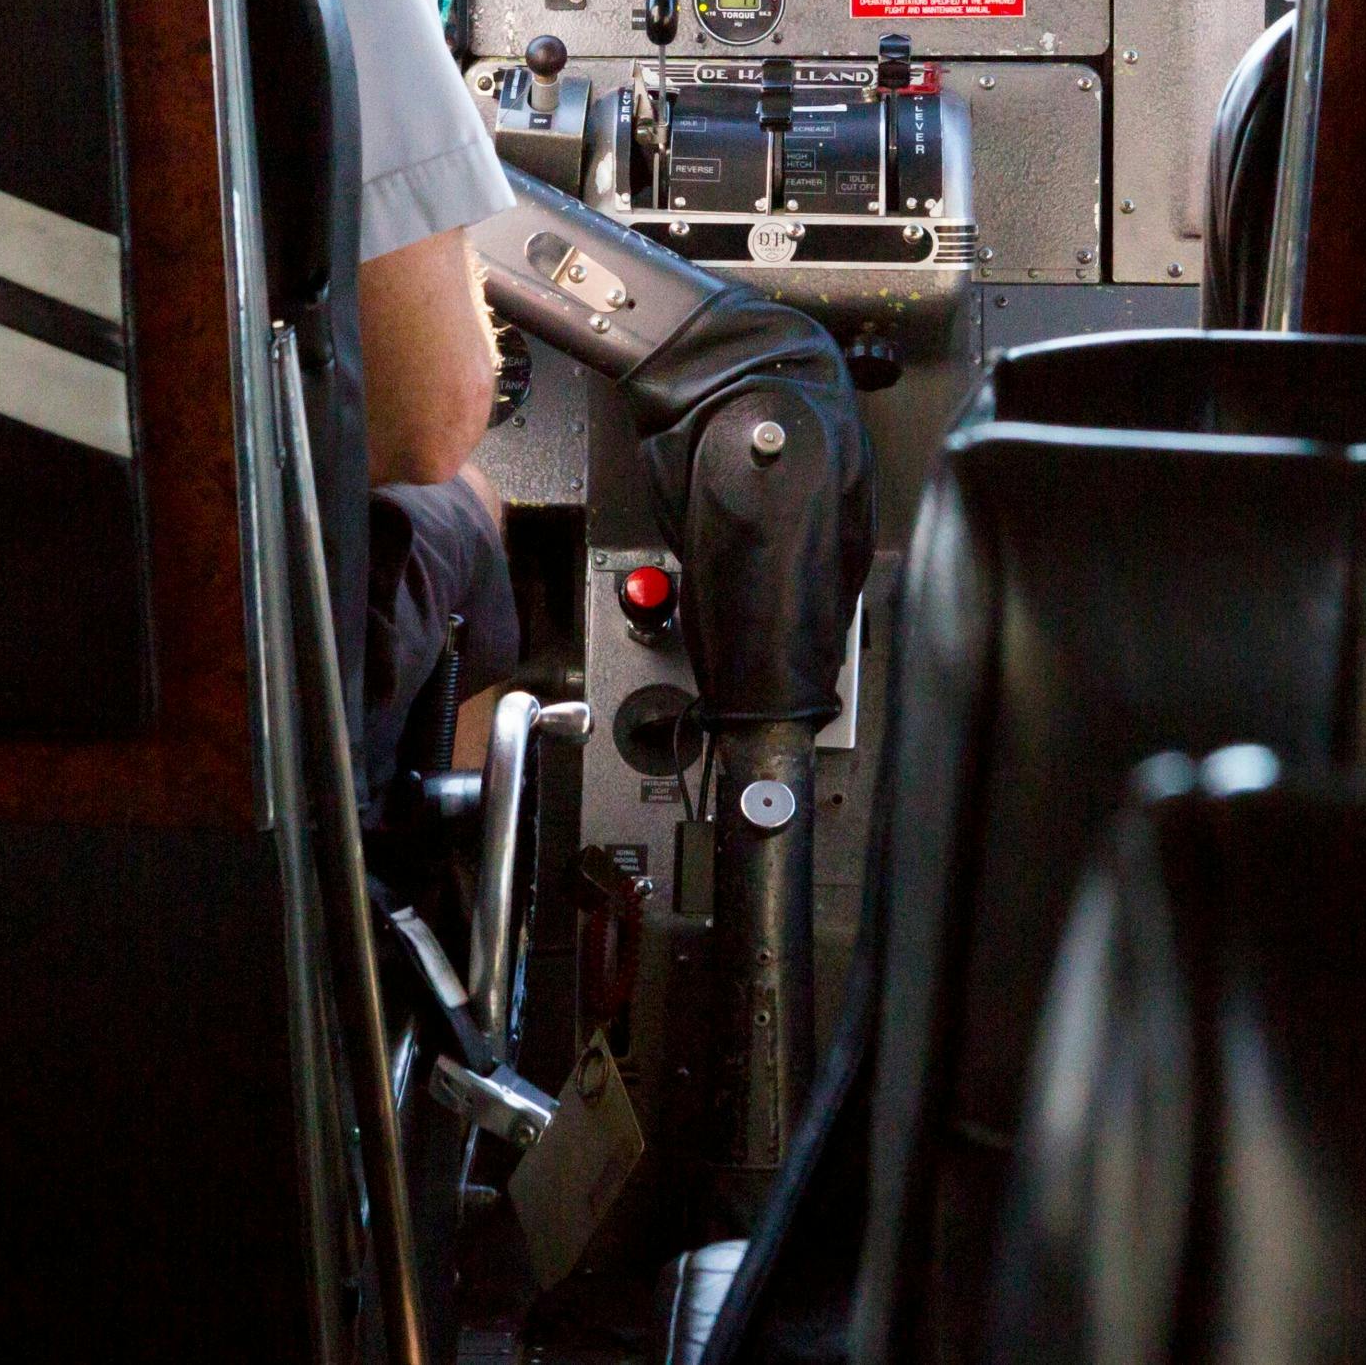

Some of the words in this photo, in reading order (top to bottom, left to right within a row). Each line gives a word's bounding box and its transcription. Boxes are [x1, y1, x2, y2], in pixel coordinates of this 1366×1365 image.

[702, 69, 728, 80] DE
[738, 69, 871, 82] HALLAND
[676, 165, 714, 174] REVERSE
